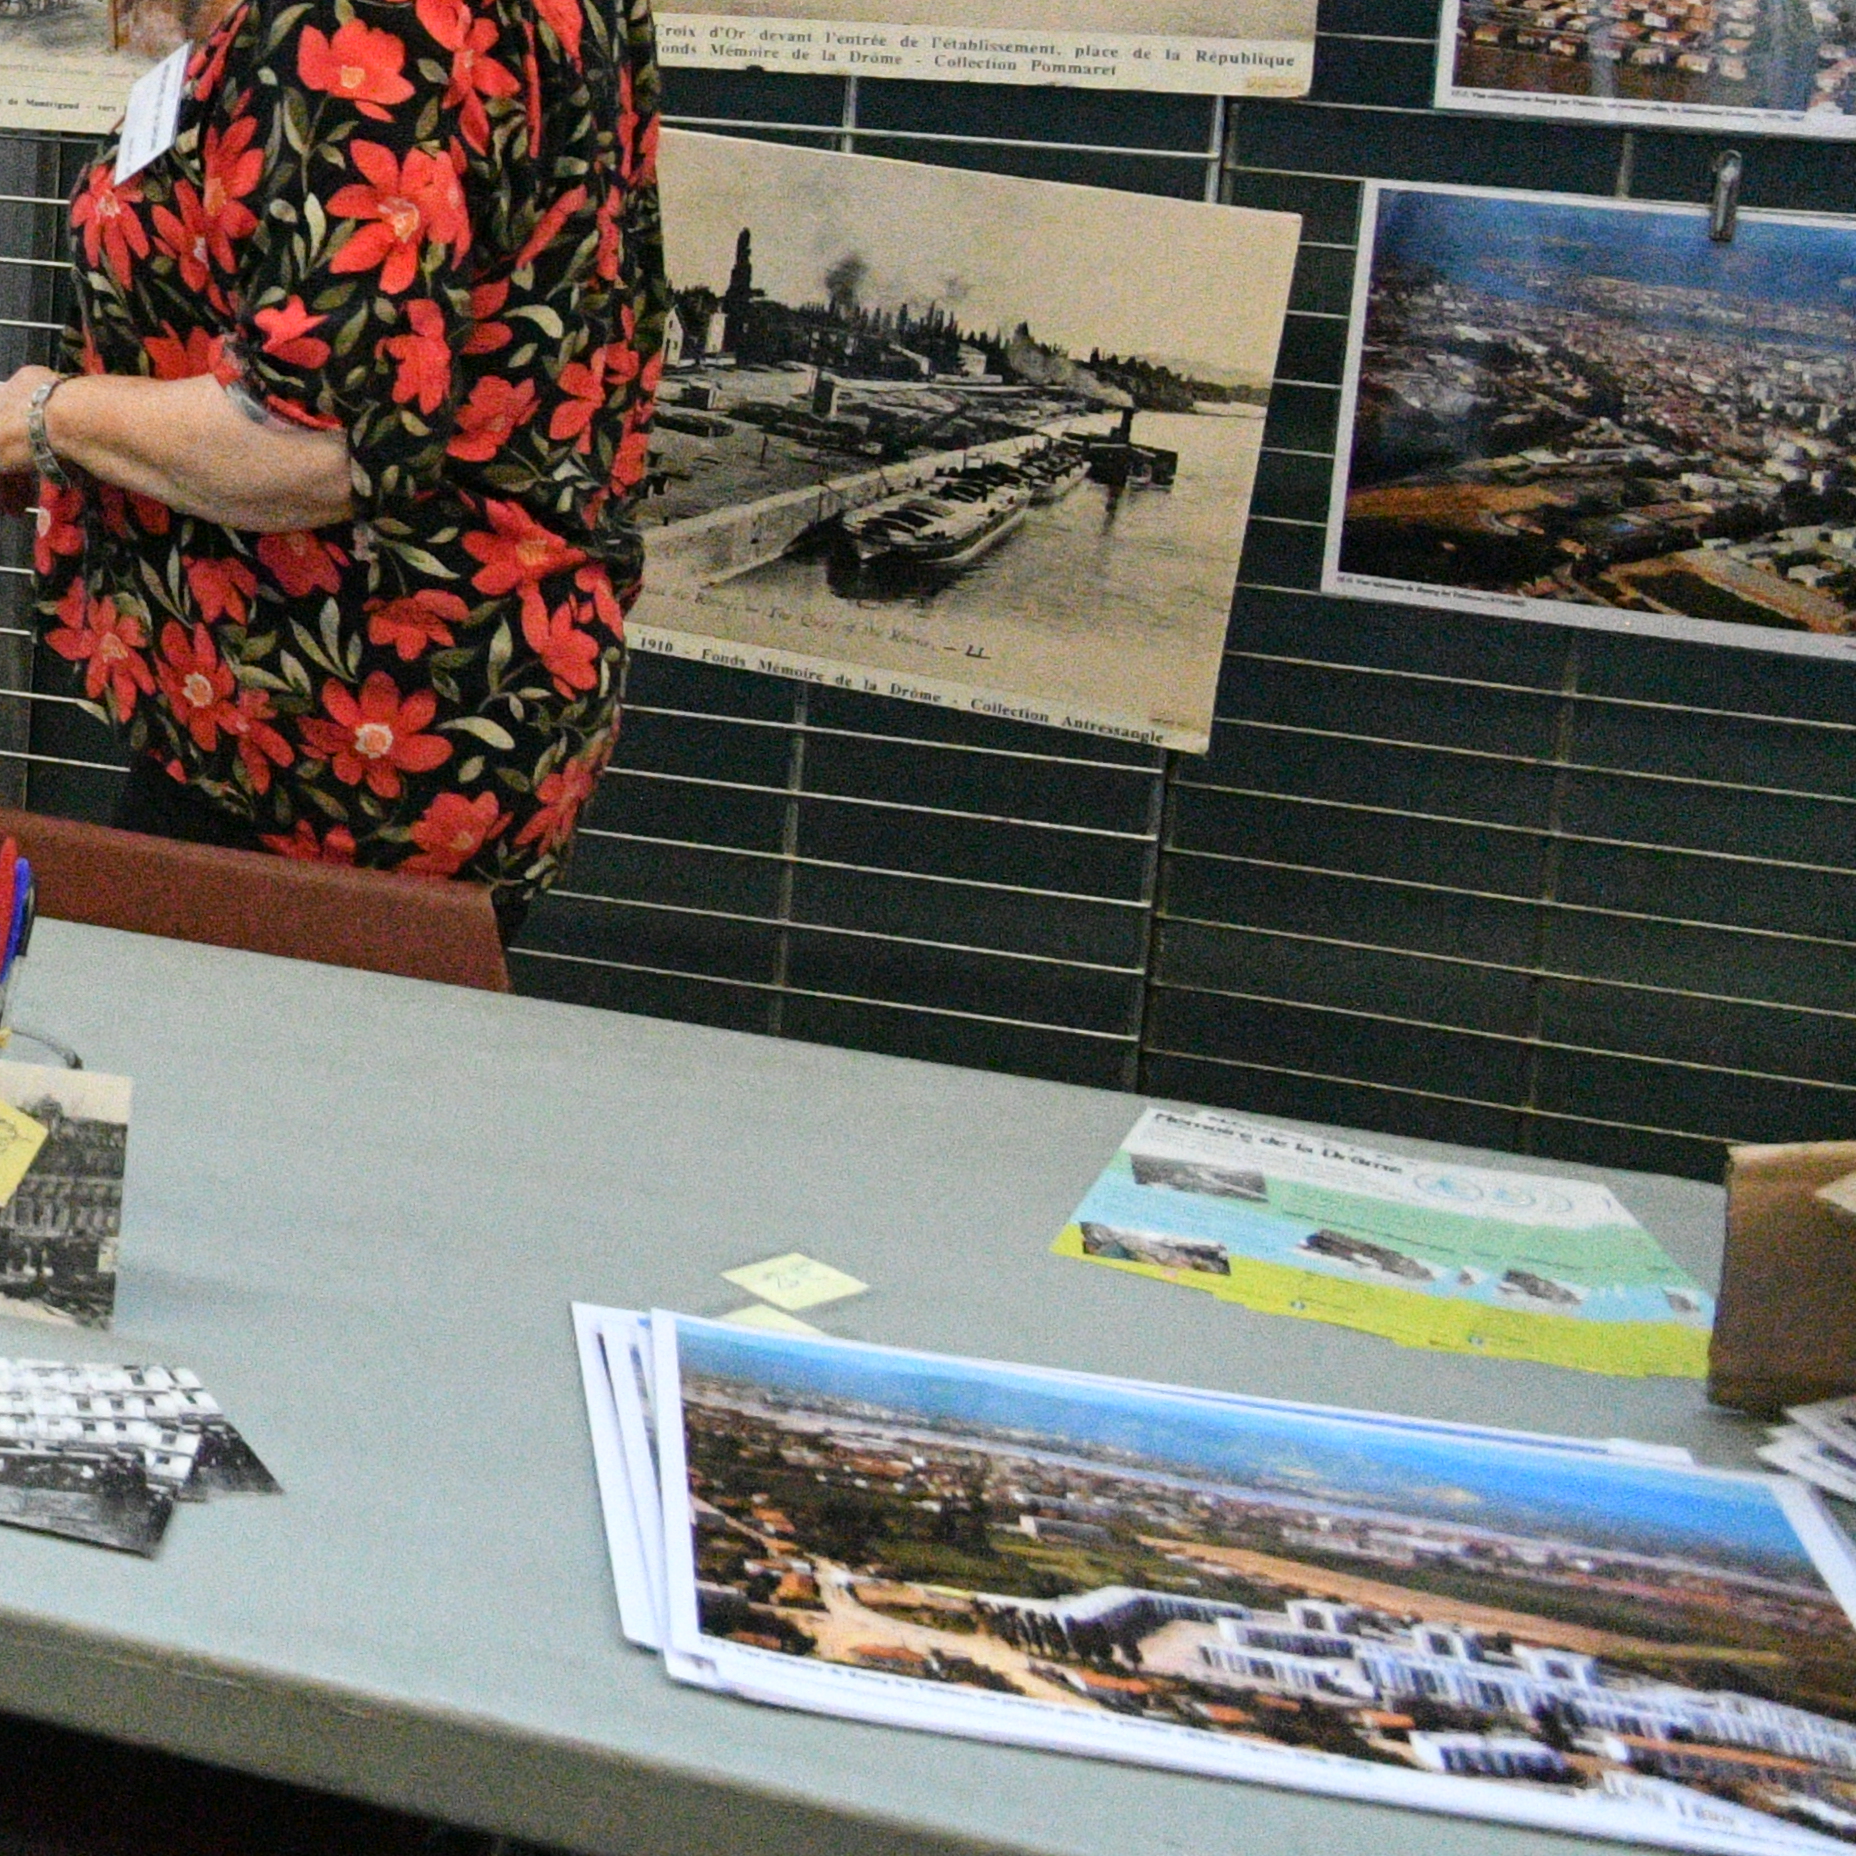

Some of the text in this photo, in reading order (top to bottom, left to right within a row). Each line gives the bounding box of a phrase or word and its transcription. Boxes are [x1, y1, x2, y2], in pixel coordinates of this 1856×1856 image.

[759, 29, 812, 43] devant
[900, 35, 918, 48] de
[1075, 45, 1118, 60] place
[1133, 47, 1151, 60] de
[1165, 48, 1180, 61] la
[1196, 49, 1295, 67] République
[792, 48, 810, 61] de
[822, 50, 836, 62] la
[934, 54, 1017, 71] Collection
[1031, 59, 1116, 75] Pommaret
[640, 636, 674, 653] 1910
[701, 648, 747, 668] Fonds
[835, 674, 852, 687] de
[864, 678, 877, 692] la
[971, 697, 1050, 723] Collection
